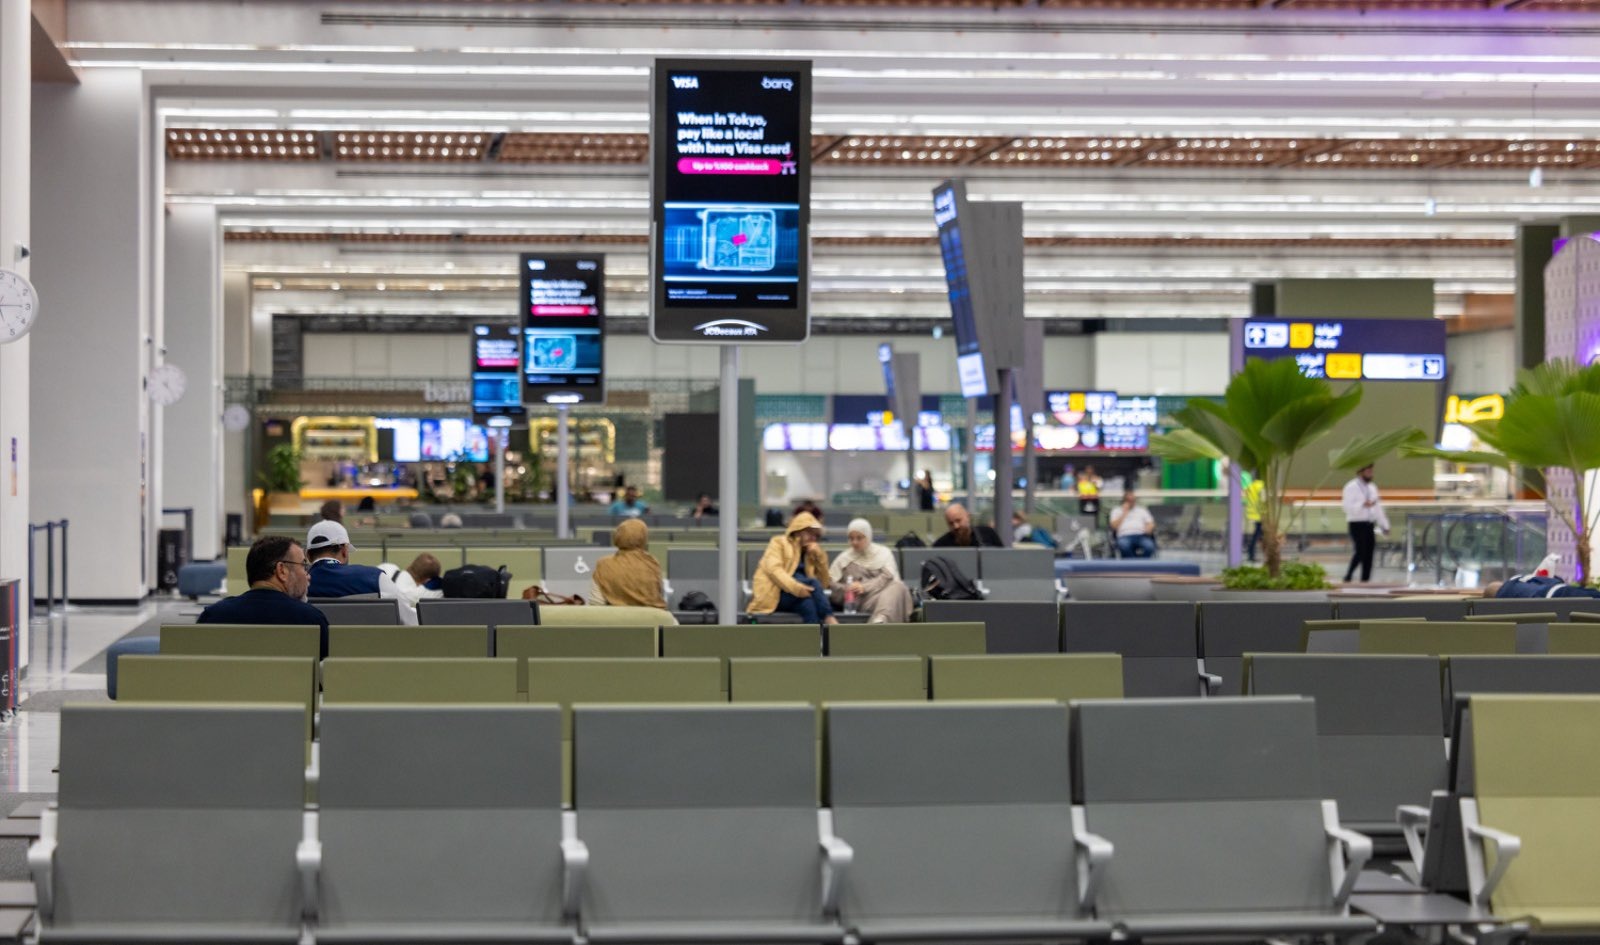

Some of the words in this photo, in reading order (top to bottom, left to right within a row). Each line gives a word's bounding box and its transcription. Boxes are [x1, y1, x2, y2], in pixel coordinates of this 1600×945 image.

[672, 76, 698, 88] VISA
[761, 76, 793, 90] barq
[677, 112, 714, 126] When
[715, 112, 727, 126] in
[728, 113, 767, 127] Tokyo,
[677, 129, 700, 141] pay
[702, 127, 723, 140] like
[725, 131, 733, 140] a
[734, 128, 764, 140] local
[677, 142, 704, 154] with
[705, 142, 734, 156] barq
[735, 143, 761, 155] Visa
[763, 142, 791, 155] card
[703, 327, 742, 336] JCDecaux
